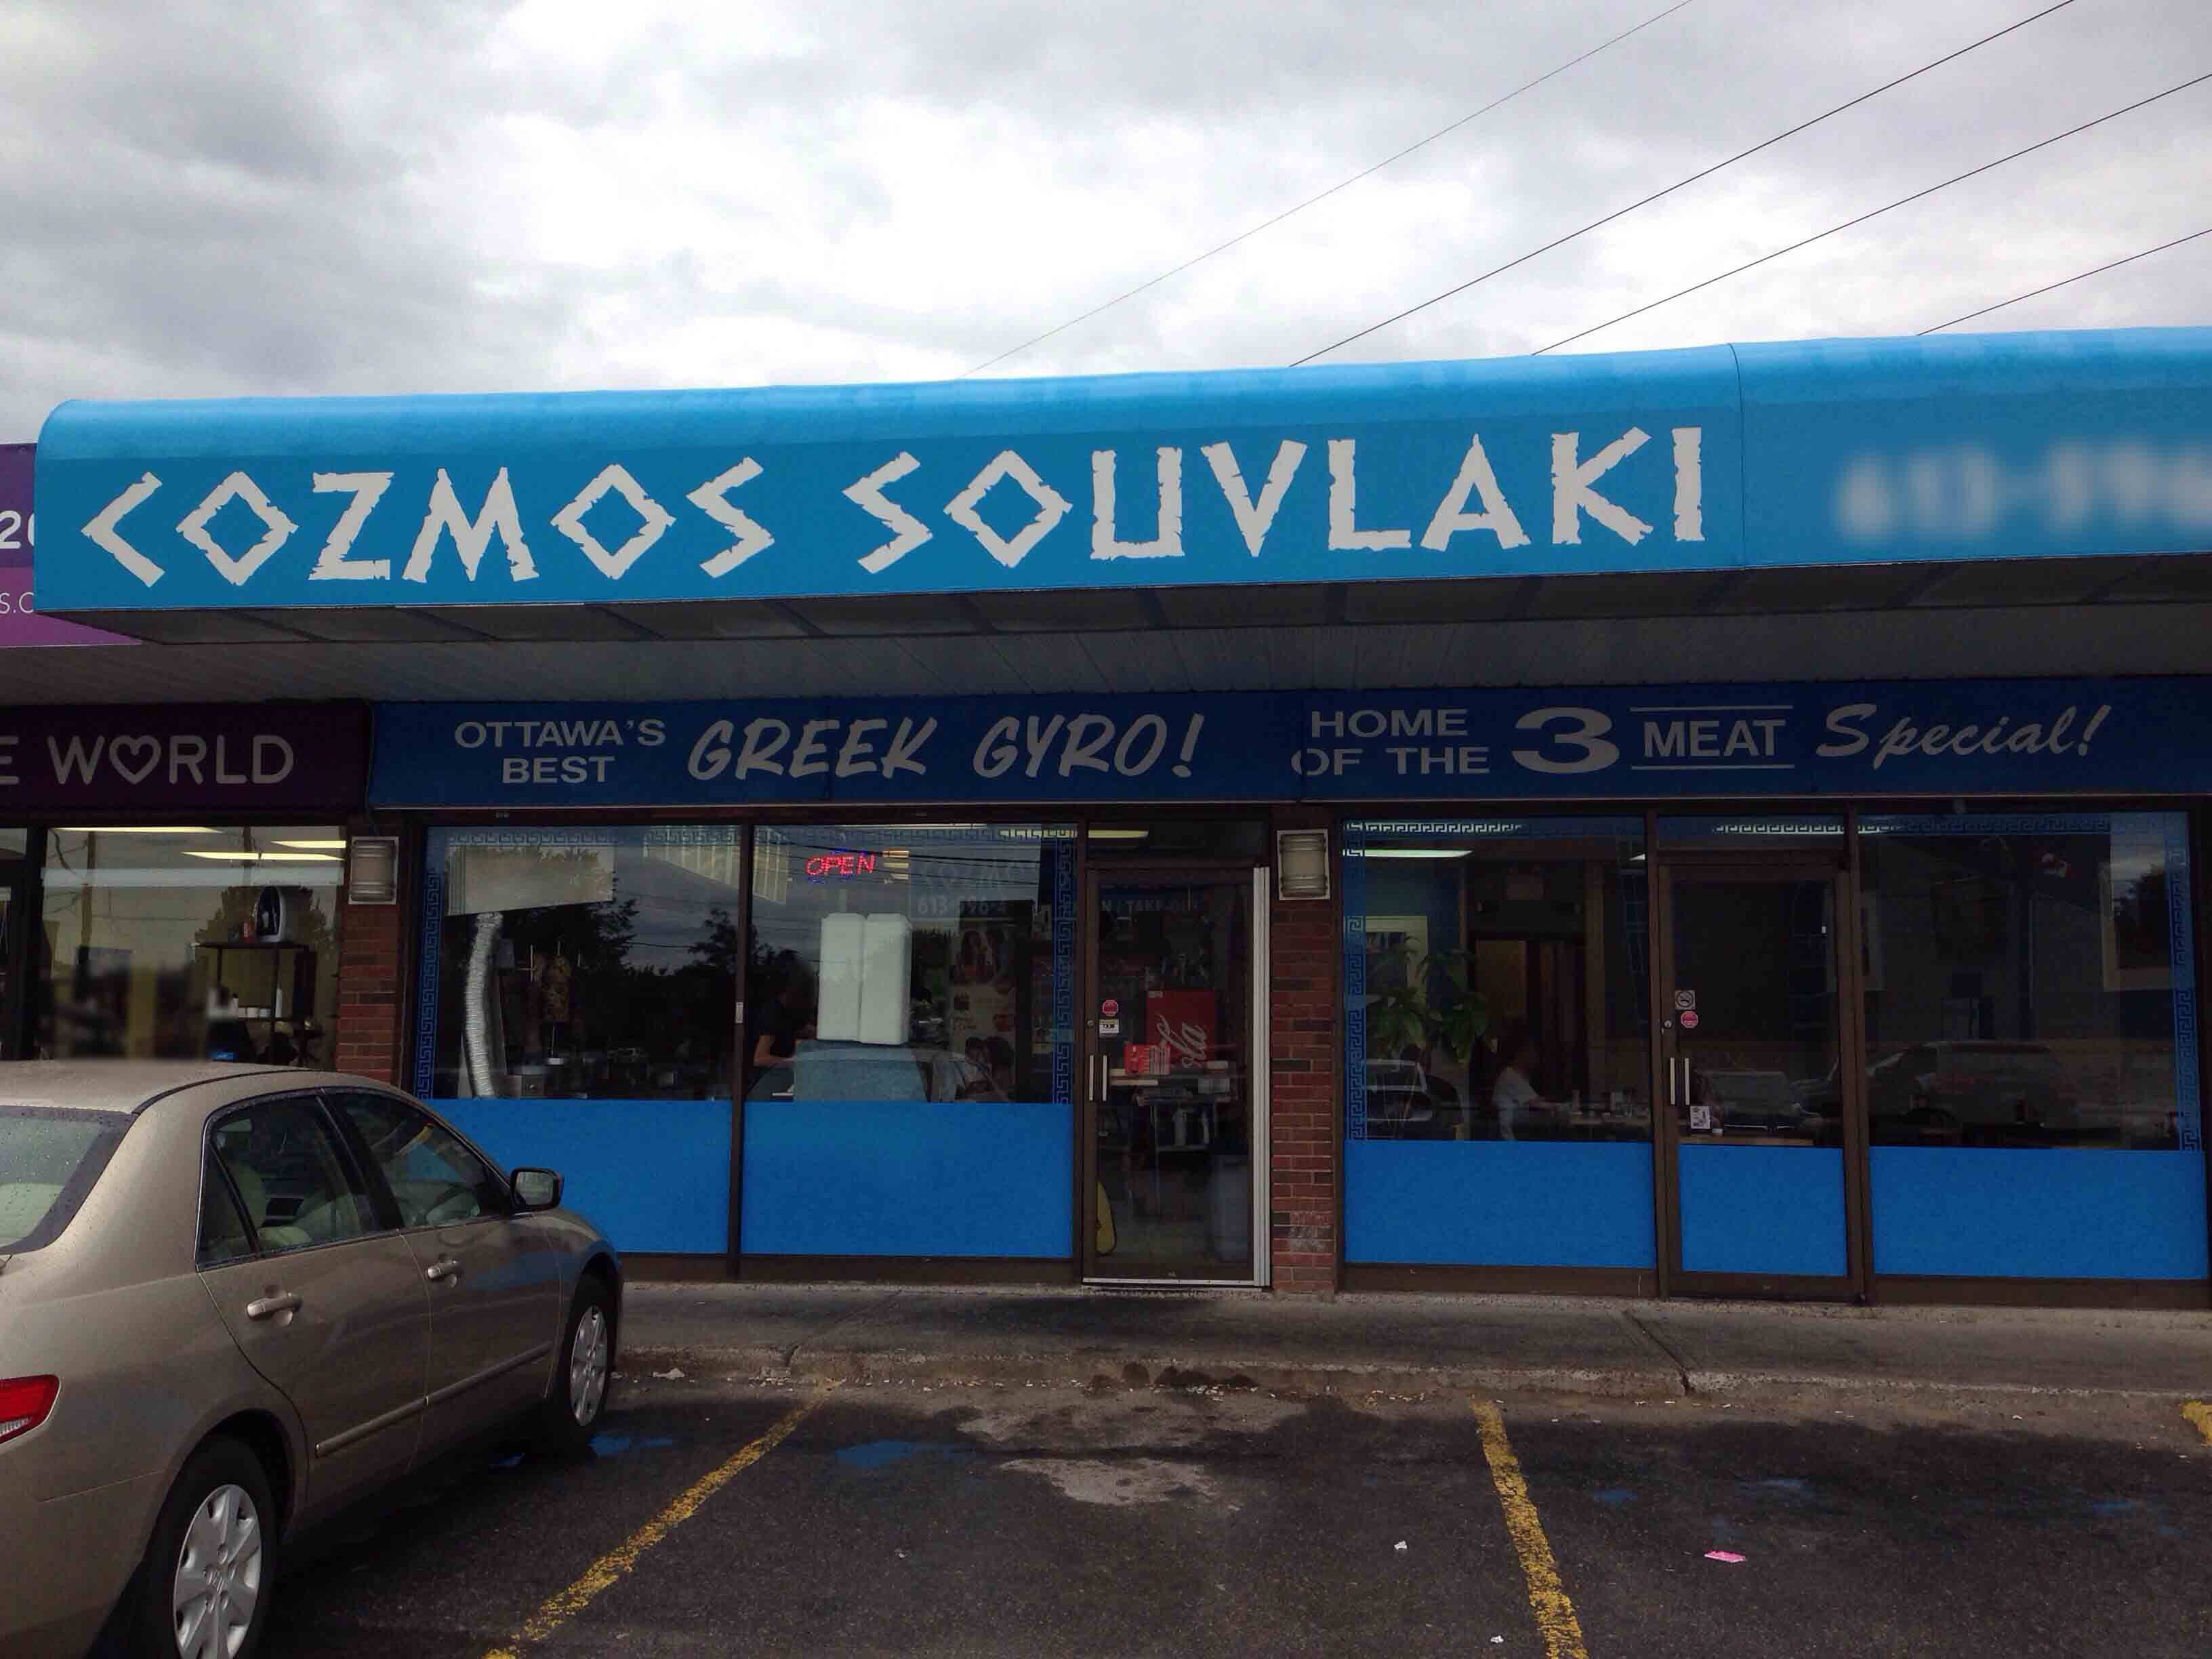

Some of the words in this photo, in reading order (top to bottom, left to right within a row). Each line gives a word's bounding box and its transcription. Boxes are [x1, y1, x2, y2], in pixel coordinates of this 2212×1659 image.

[81, 456, 775, 588] COZMOS
[842, 426, 1706, 574] SOUVLAKI
[455, 719, 665, 749] OTTAWA'S
[1311, 708, 1468, 738] HOME
[1512, 707, 1620, 774] 3
[1644, 719, 1786, 758] MEAT
[1816, 703, 2112, 770] Special!
[48, 735, 293, 785] WORLD
[688, 716, 937, 781] GREEK
[972, 713, 1204, 778] GYRO!
[1291, 748, 1361, 776] OF
[1385, 747, 1490, 775] THE
[502, 756, 615, 783] BEST
[806, 855, 875, 876] OPEN
